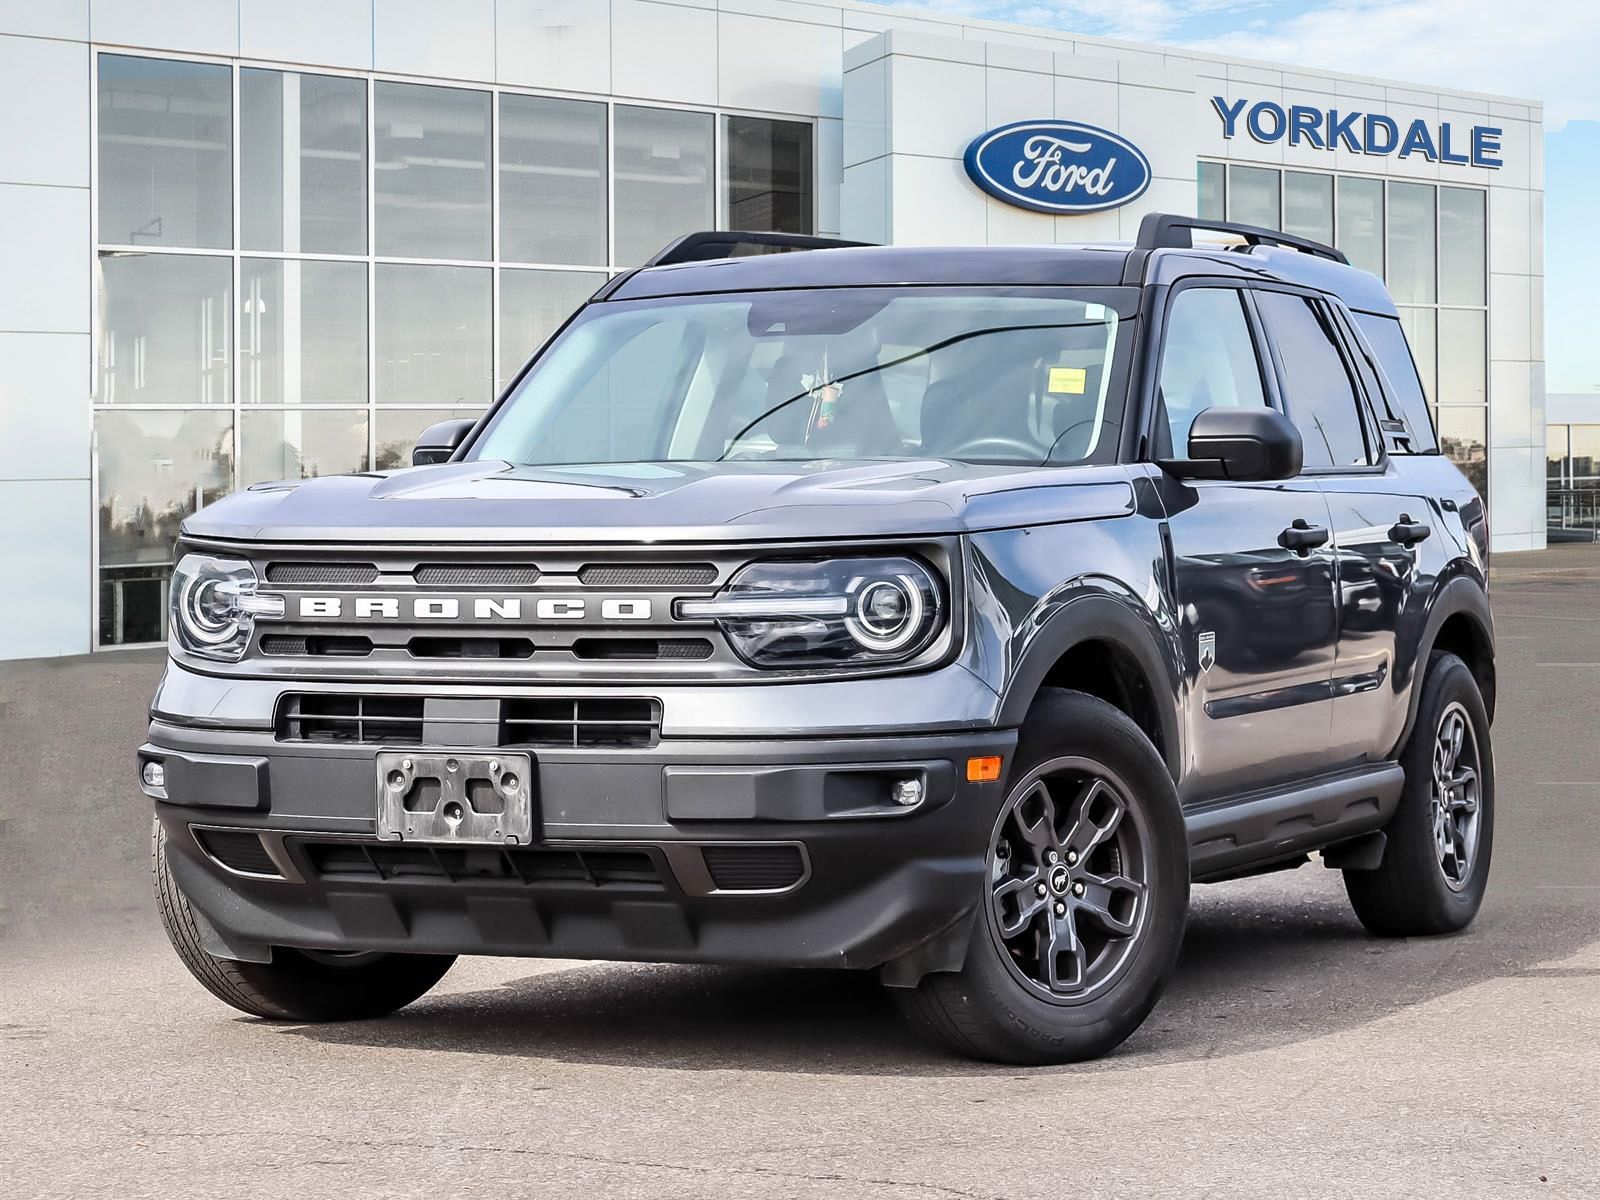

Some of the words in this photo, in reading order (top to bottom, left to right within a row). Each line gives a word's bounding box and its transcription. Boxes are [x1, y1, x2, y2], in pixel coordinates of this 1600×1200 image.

[1210, 96, 1503, 168] YORKDALE
[1012, 135, 1117, 196] Ford
[299, 597, 652, 620] BRONCO
